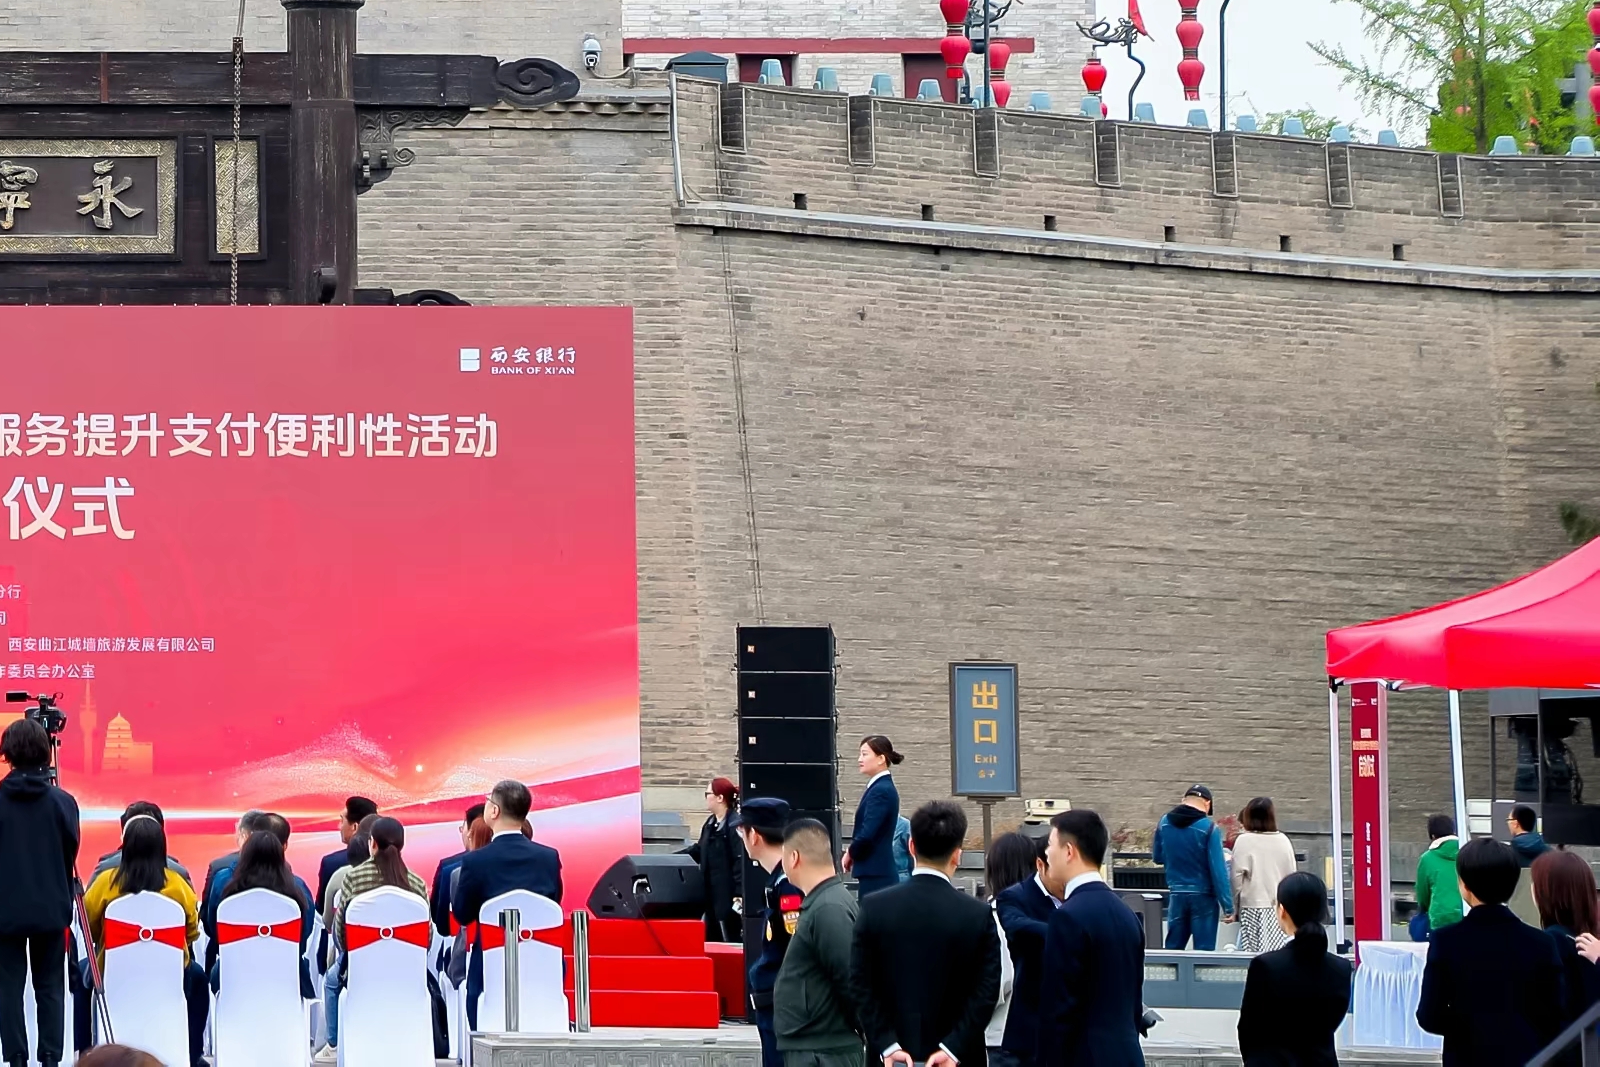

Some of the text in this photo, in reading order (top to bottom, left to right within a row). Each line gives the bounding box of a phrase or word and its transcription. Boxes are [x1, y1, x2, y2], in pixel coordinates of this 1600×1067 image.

[491, 366, 575, 375] BANK OF XI'AN
[8, 636, 216, 652] 西安曲江城墙旅游发展有限公司
[971, 680, 998, 744] 出口
[974, 753, 998, 764] Exit
